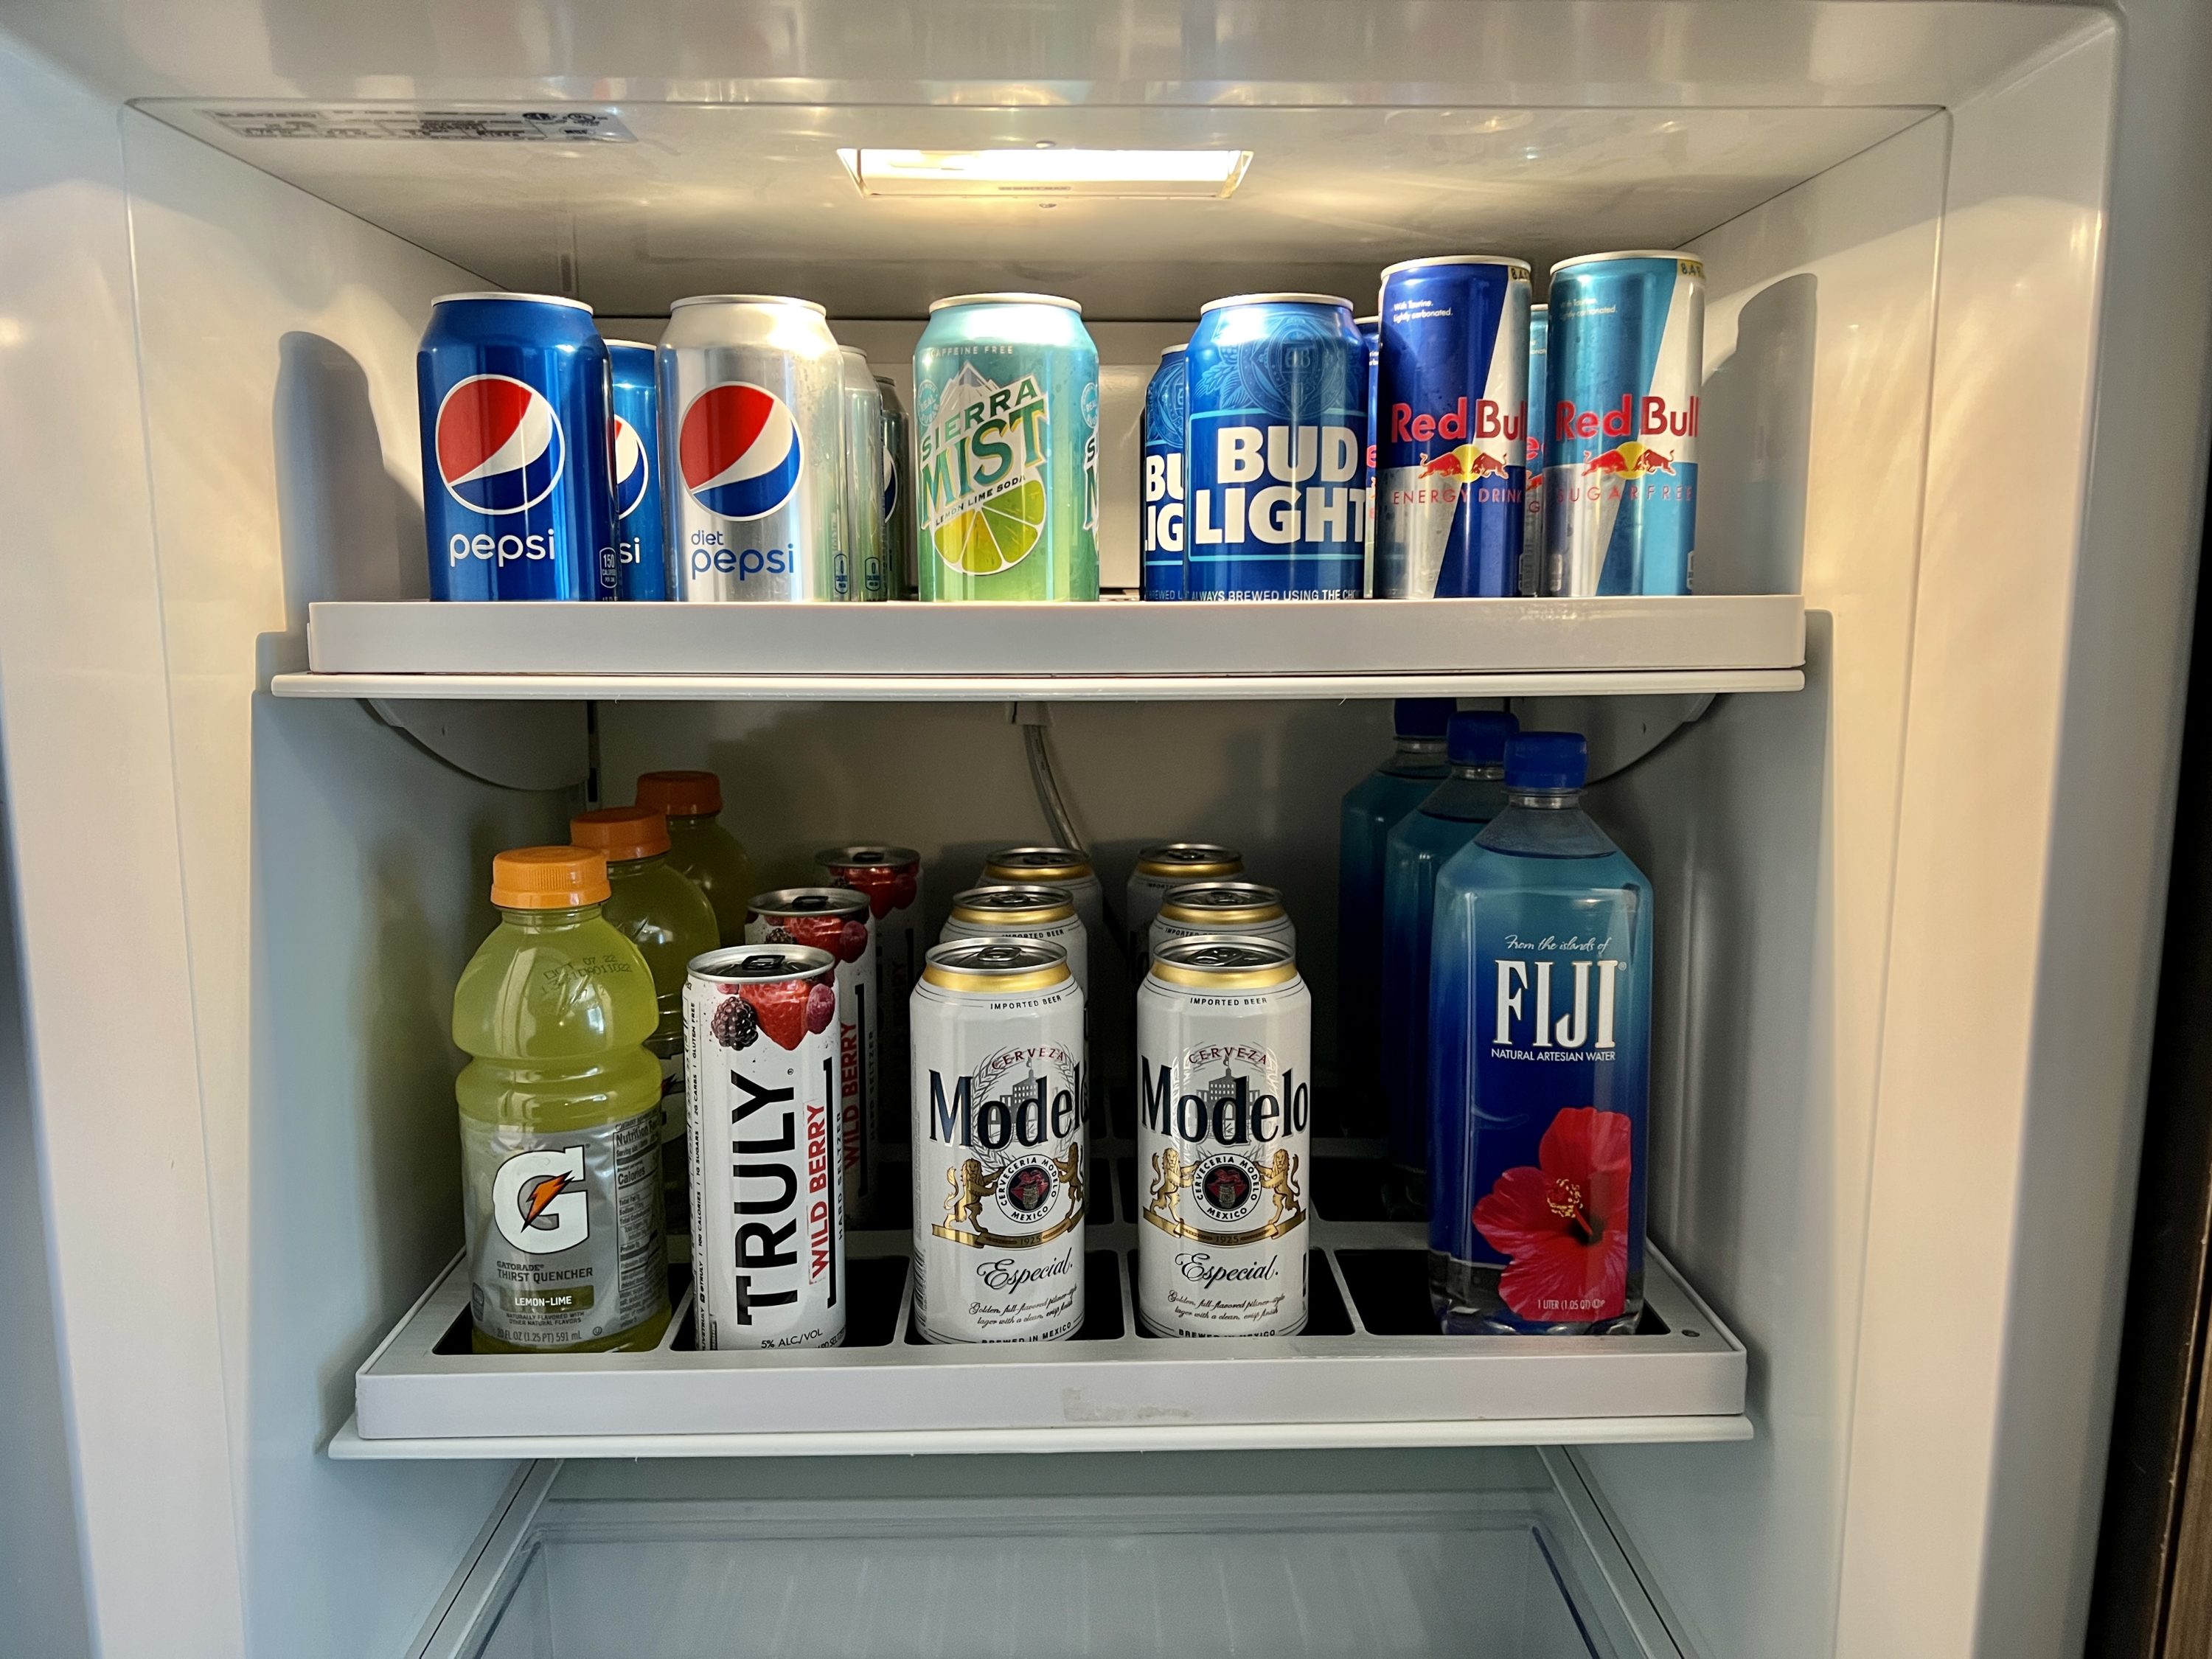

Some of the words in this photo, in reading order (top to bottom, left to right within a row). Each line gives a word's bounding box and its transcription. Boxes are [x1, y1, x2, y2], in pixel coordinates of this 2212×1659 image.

[1411, 307, 1453, 319] carbonated.
[930, 346, 978, 358] CAFFEINE
[984, 346, 1013, 355] FREE
[922, 378, 1038, 462] SIERRA
[1391, 396, 1467, 442] Red
[1556, 394, 1632, 441] Red
[1640, 395, 1700, 439] Bull
[920, 398, 1046, 528] MIST
[1217, 425, 1359, 484] BUD
[1146, 453, 1184, 502] BU
[936, 504, 964, 526] LEMON
[968, 488, 993, 507] LIME
[997, 475, 1026, 493] SODA
[1393, 487, 1468, 505] ENERGY
[1478, 488, 1522, 504] DRINK
[1195, 485, 1366, 544] LIGHT
[450, 528, 555, 568] pepsi
[691, 530, 724, 546] diet
[603, 554, 615, 568] 150
[692, 543, 795, 581] pepsi
[1228, 590, 1279, 602] BREWED
[1284, 589, 1319, 601] USING
[1322, 589, 1341, 599] THE
[1047, 929, 1064, 937] BEER
[1505, 934, 1534, 950] From
[1537, 935, 1558, 951] the
[1559, 936, 1594, 952] islands
[1597, 936, 1612, 955] of
[990, 1000, 1039, 1009] IMPORTED
[1043, 995, 1062, 1005] BEER
[1189, 997, 1239, 1006] IMPORTED
[1244, 997, 1267, 1005] BEER
[1492, 959, 1618, 1049] FIJI
[841, 1020, 858, 1096] BERRY
[991, 1047, 1064, 1069] CERVEZA
[1188, 1047, 1267, 1065] CERVEZA
[1491, 1048, 1535, 1061] NATURAL
[1537, 1051, 1584, 1062] ARTESIAN
[1585, 1051, 1615, 1062] WATER
[1141, 1054, 1309, 1147] Modelo
[616, 1124, 649, 1147] Nutrition
[843, 1105, 861, 1171] WILD
[807, 1105, 827, 1194] BERRY
[618, 1166, 645, 1185] Calories
[998, 1157, 1037, 1206] CERVECERIA
[1042, 1159, 1058, 1197] MODELO
[1195, 1156, 1234, 1200] CERVECERIA
[1239, 1160, 1259, 1200] MODELO
[493, 1145, 590, 1255] G
[731, 1069, 799, 1326] TRULY
[1011, 1206, 1048, 1221] MEXICO
[1207, 1207, 1248, 1220] MEXICO
[810, 1200, 830, 1279] WILD
[1020, 1236, 1041, 1245] 1925
[1216, 1236, 1239, 1244] 1925
[497, 1261, 540, 1271] GATORADE
[498, 1268, 529, 1282] THIRST
[533, 1267, 593, 1284] QUENCHER
[515, 1295, 572, 1307] LEMON-LIME
[554, 1317, 582, 1325] FLAVORS
[977, 1317, 997, 1329] lager
[999, 1315, 1015, 1325] with
[1175, 1306, 1192, 1318] lager
[504, 1329, 512, 1340] FL
[513, 1331, 523, 1341] OZ
[524, 1331, 541, 1342] (1.25
[542, 1332, 554, 1343] PT)
[556, 1332, 568, 1342] 591
[571, 1330, 582, 1340] mL
[761, 1340, 775, 1349] 5%
[779, 1328, 823, 1348] ALC/VOL
[1042, 1322, 1071, 1340] MEXICO
